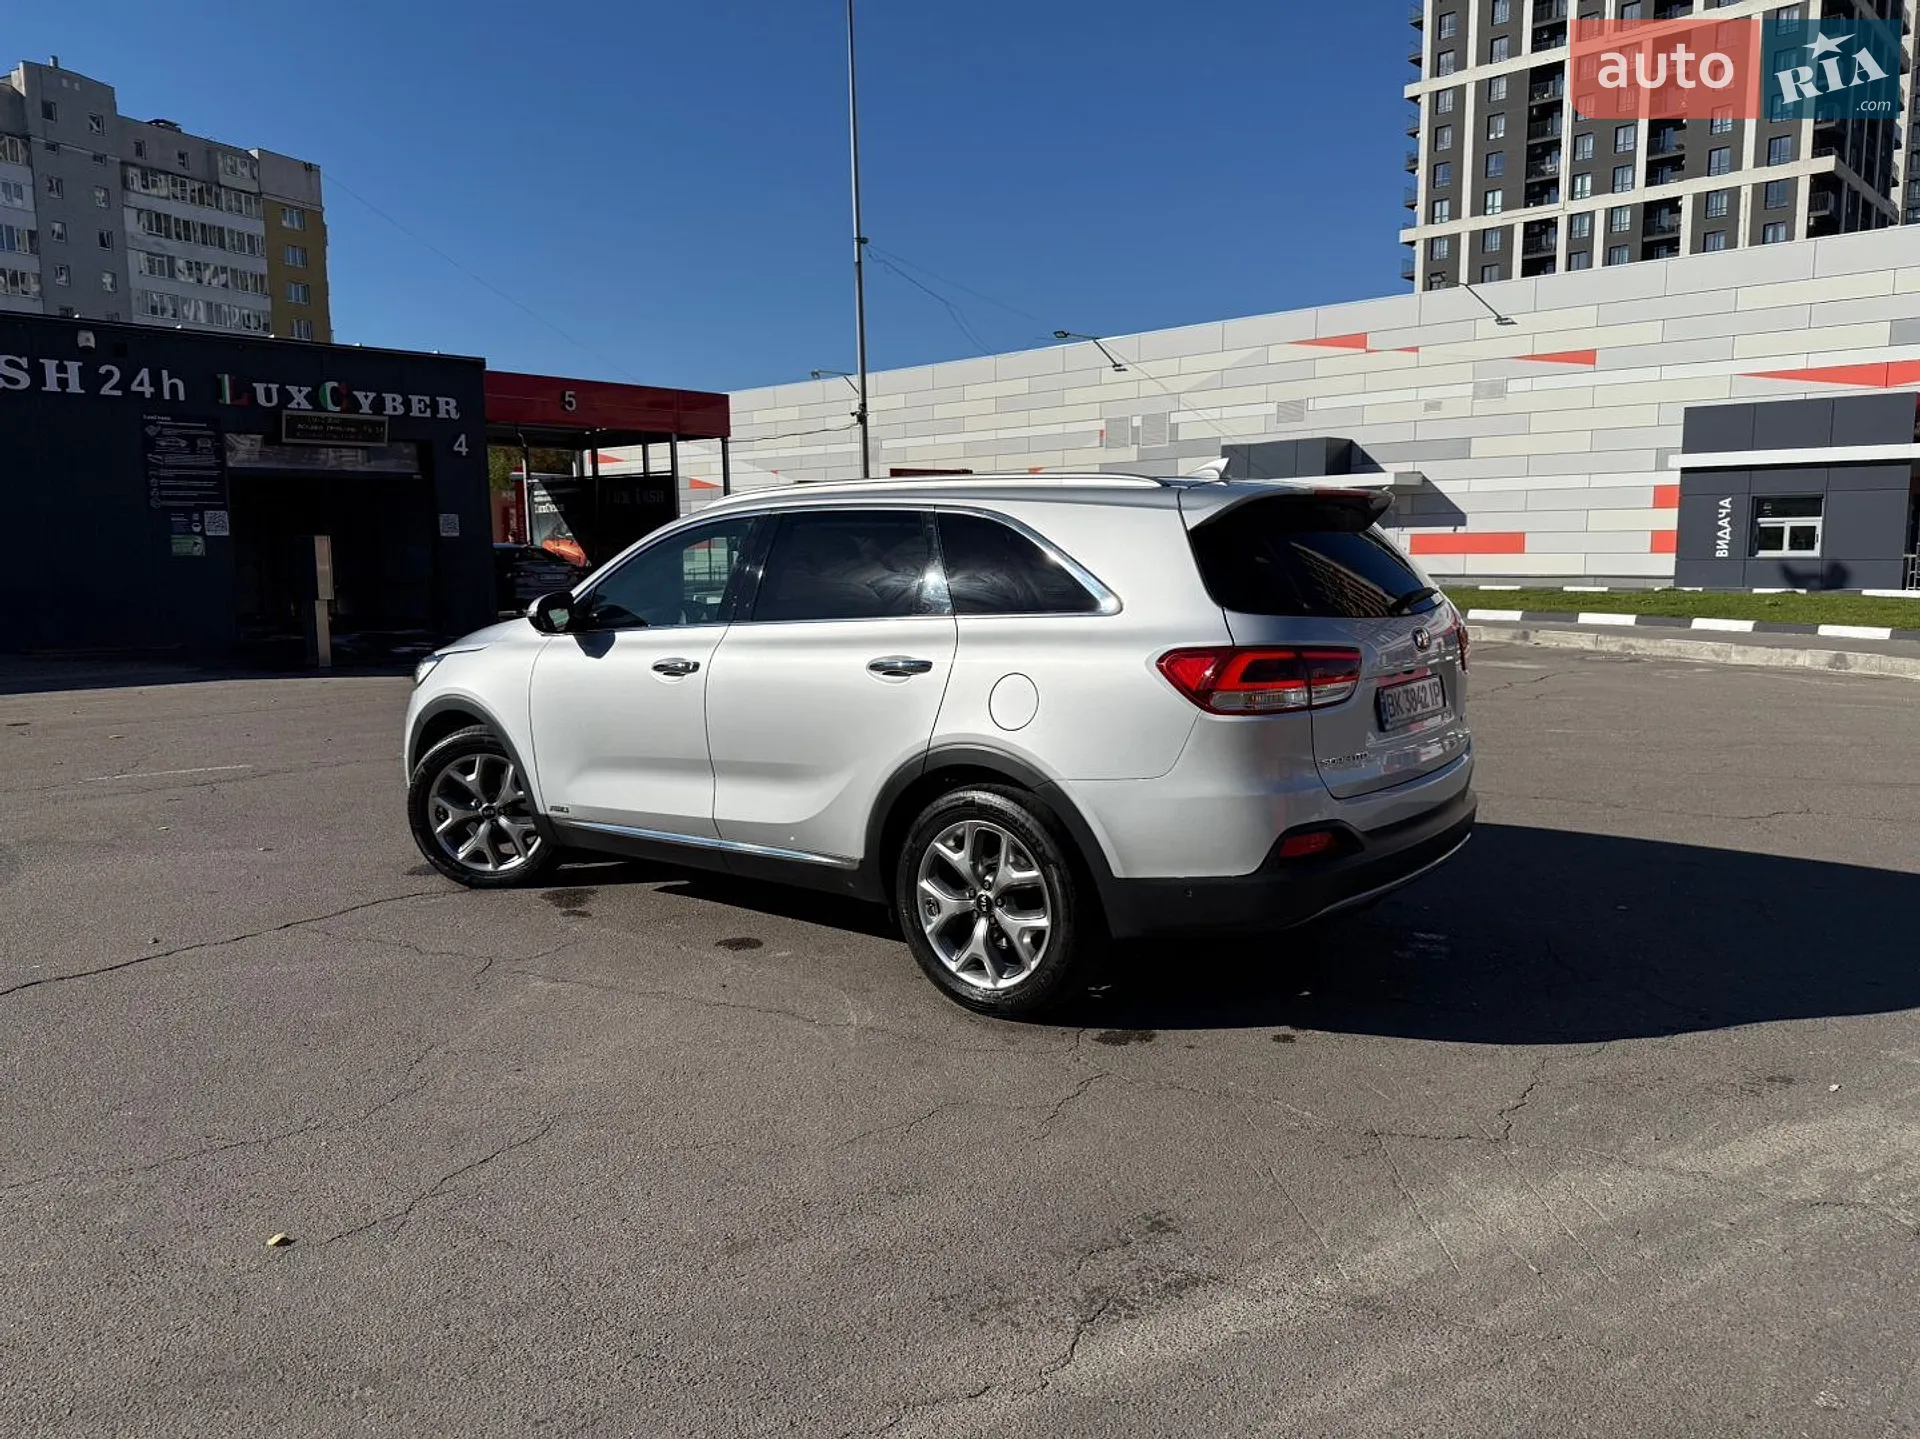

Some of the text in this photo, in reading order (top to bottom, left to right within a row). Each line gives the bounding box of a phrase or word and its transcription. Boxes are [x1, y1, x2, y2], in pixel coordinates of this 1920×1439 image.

[98, 364, 186, 401] 24h
[564, 390, 577, 411] 5
[453, 433, 469, 456] 4
[1715, 497, 1732, 558] ВИДАЧА
